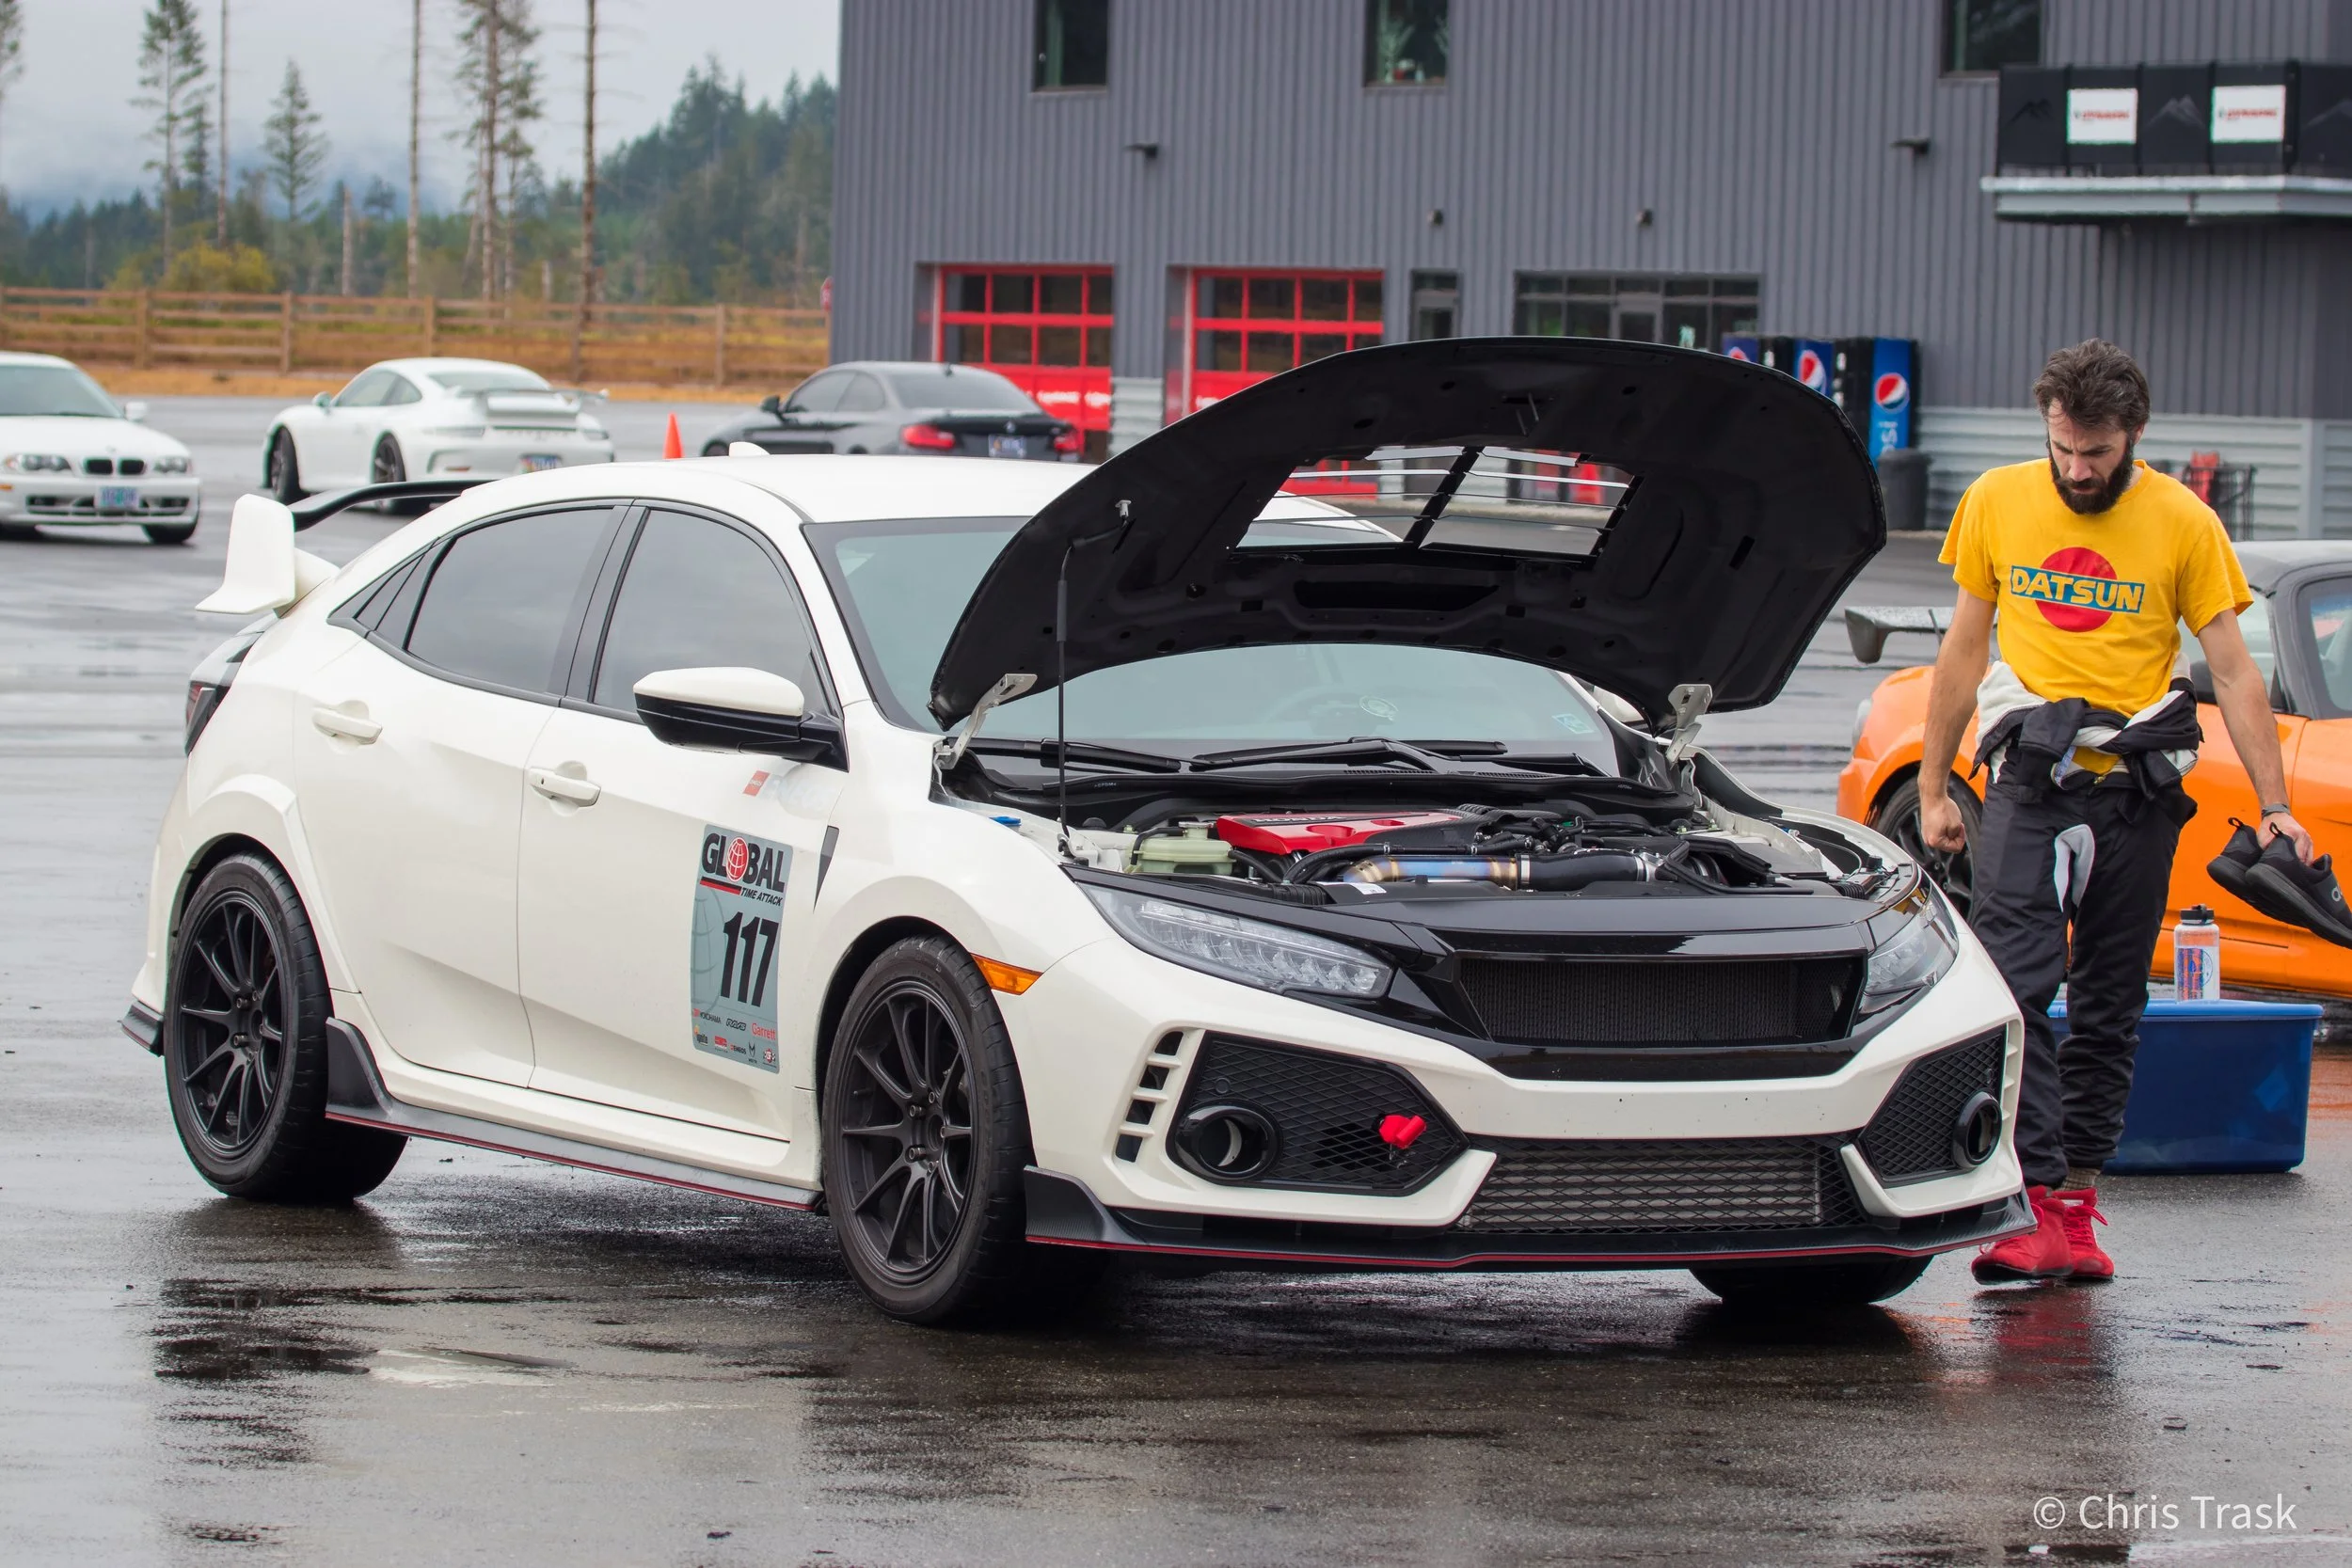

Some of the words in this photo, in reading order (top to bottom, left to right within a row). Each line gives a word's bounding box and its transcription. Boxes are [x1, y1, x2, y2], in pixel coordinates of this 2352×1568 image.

[2011, 568, 2142, 610] DATSUN
[701, 832, 785, 893] GLOBAL
[740, 887, 757, 899] TIME
[756, 892, 783, 906] ATTACK
[721, 911, 779, 1007] 117
